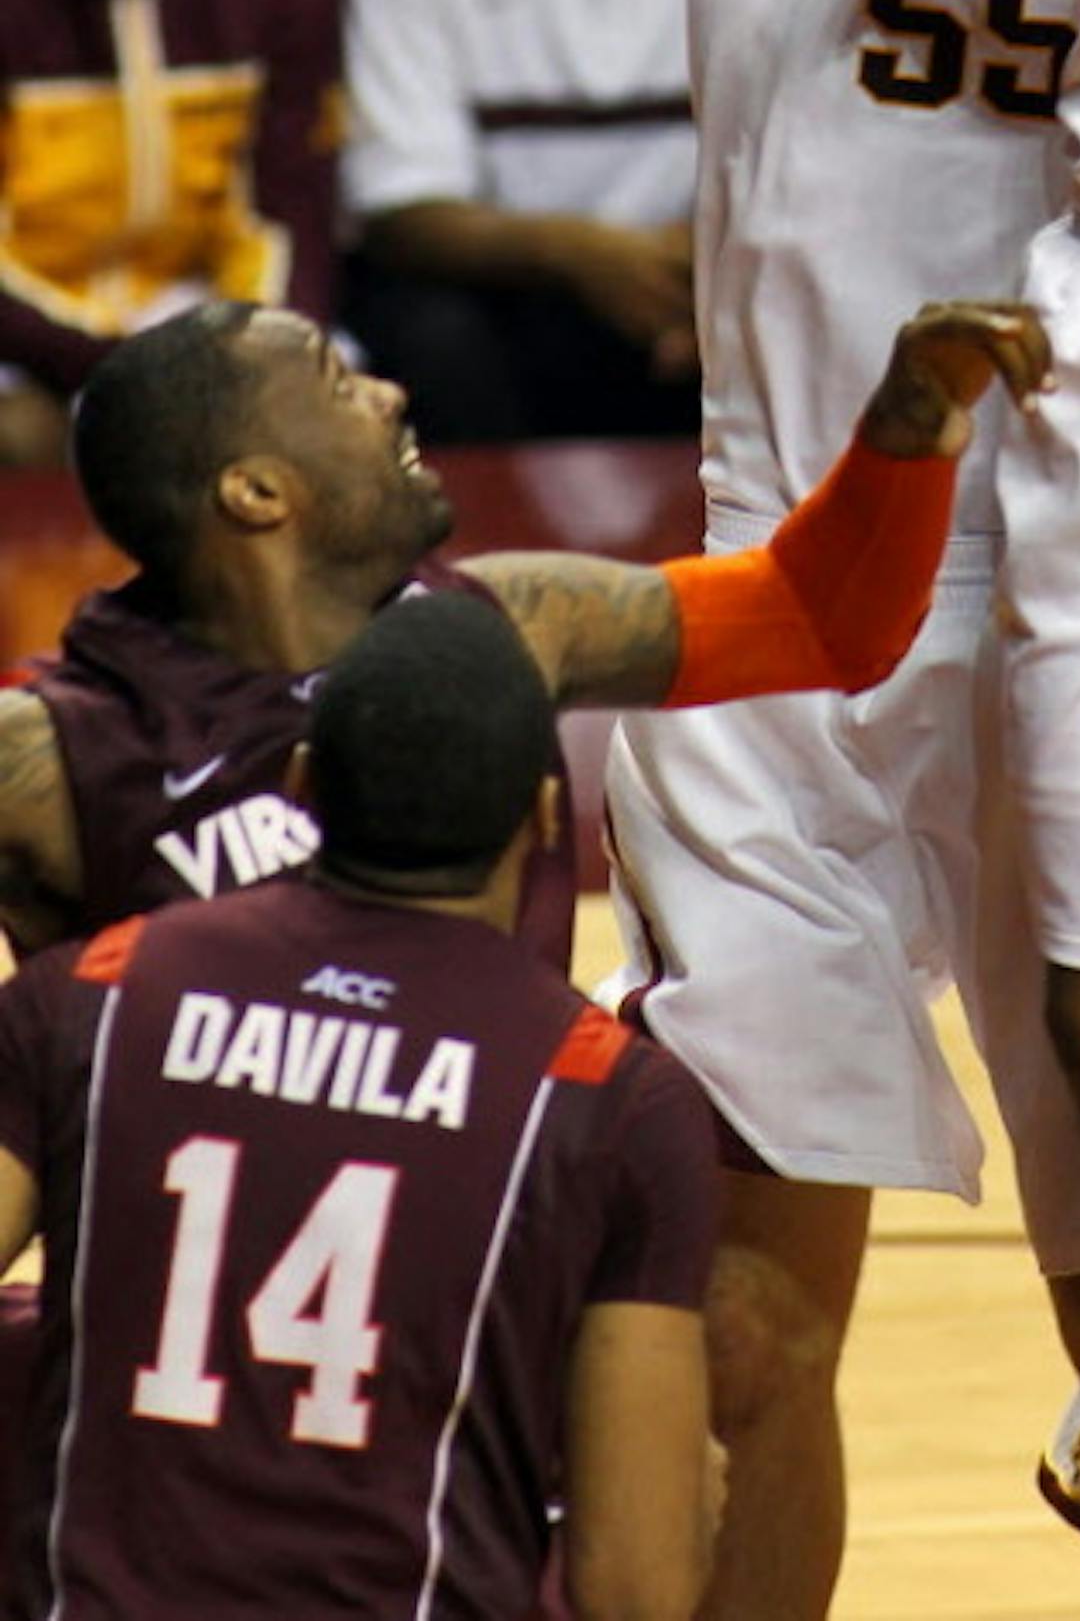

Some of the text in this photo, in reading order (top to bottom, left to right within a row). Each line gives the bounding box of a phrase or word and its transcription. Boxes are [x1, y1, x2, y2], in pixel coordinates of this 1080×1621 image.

[301, 965, 397, 1011] ACC
[161, 990, 477, 1130] DAVILA
[129, 1133, 406, 1451] 14
